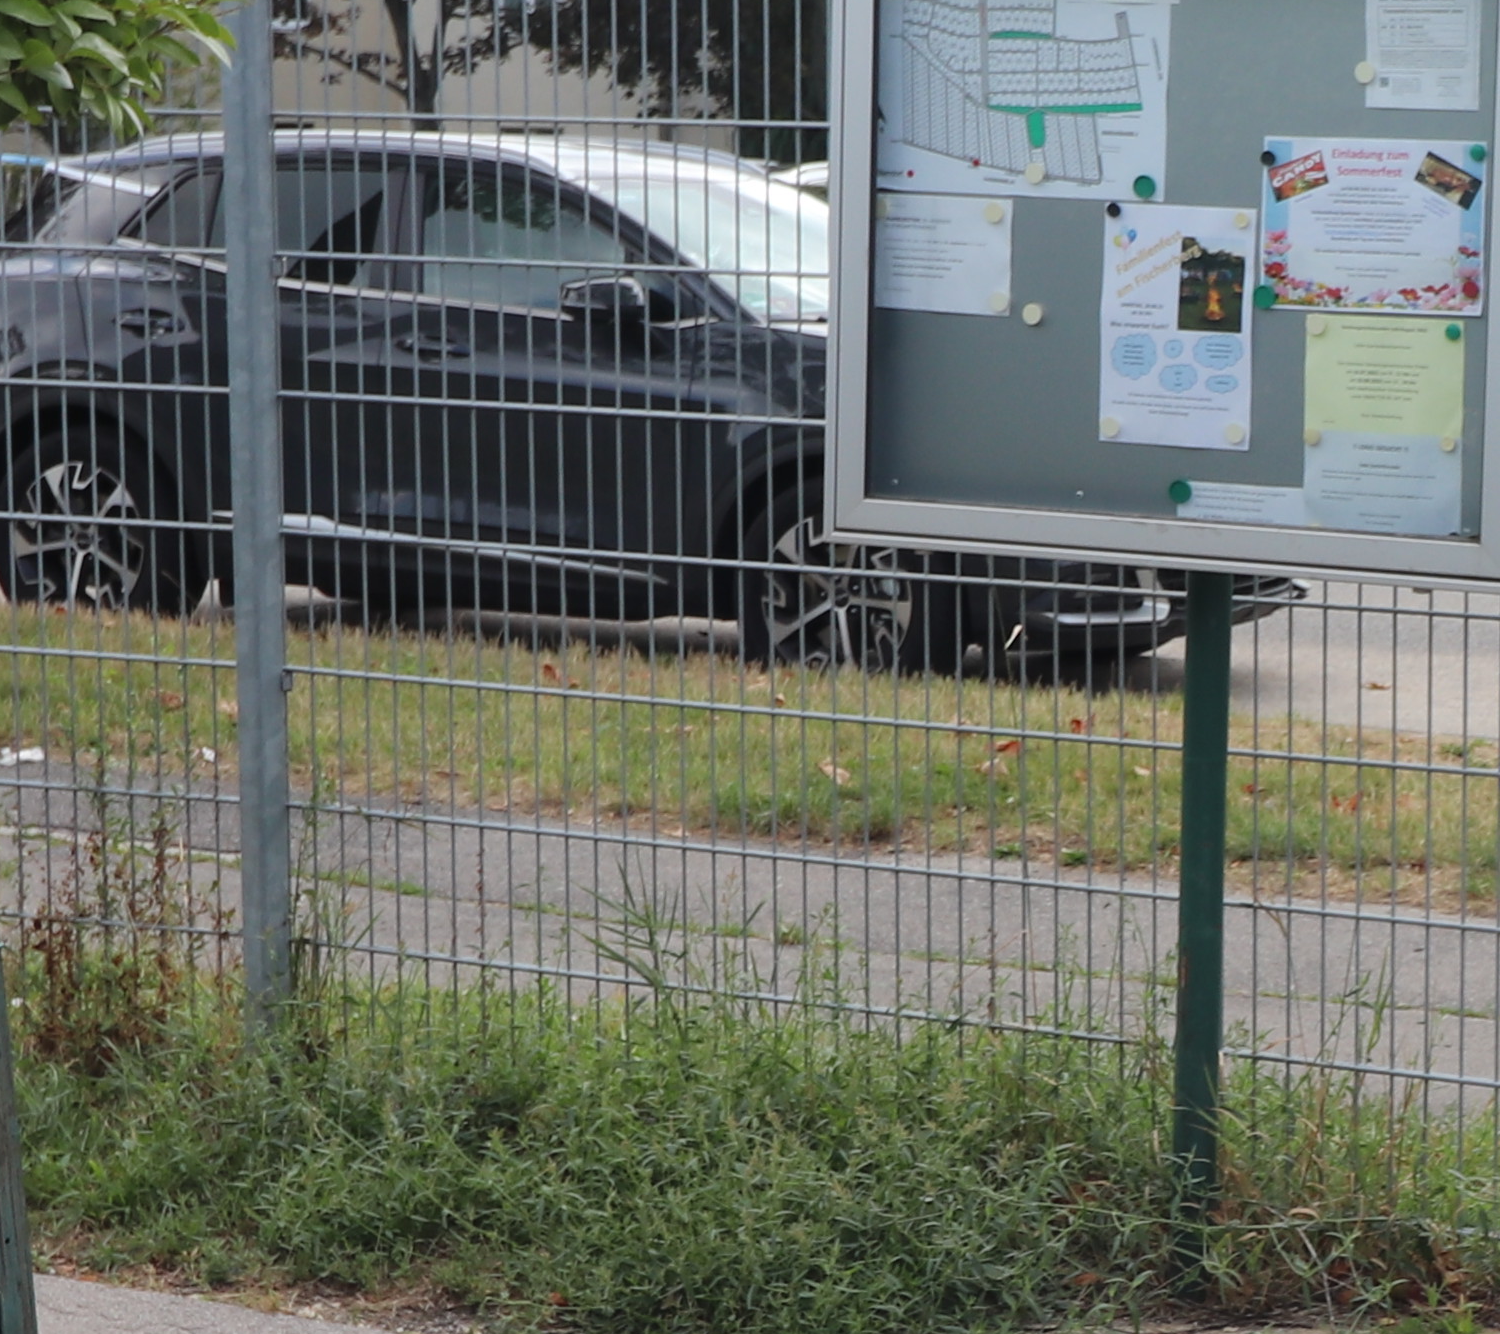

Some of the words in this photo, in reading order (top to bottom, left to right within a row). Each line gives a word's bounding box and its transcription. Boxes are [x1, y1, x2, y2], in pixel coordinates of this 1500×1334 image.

[1332, 149, 1383, 162] Einladung
[1386, 152, 1409, 160] zum
[1272, 153, 1321, 188] CANDY
[1336, 166, 1402, 177] Sommerfest
